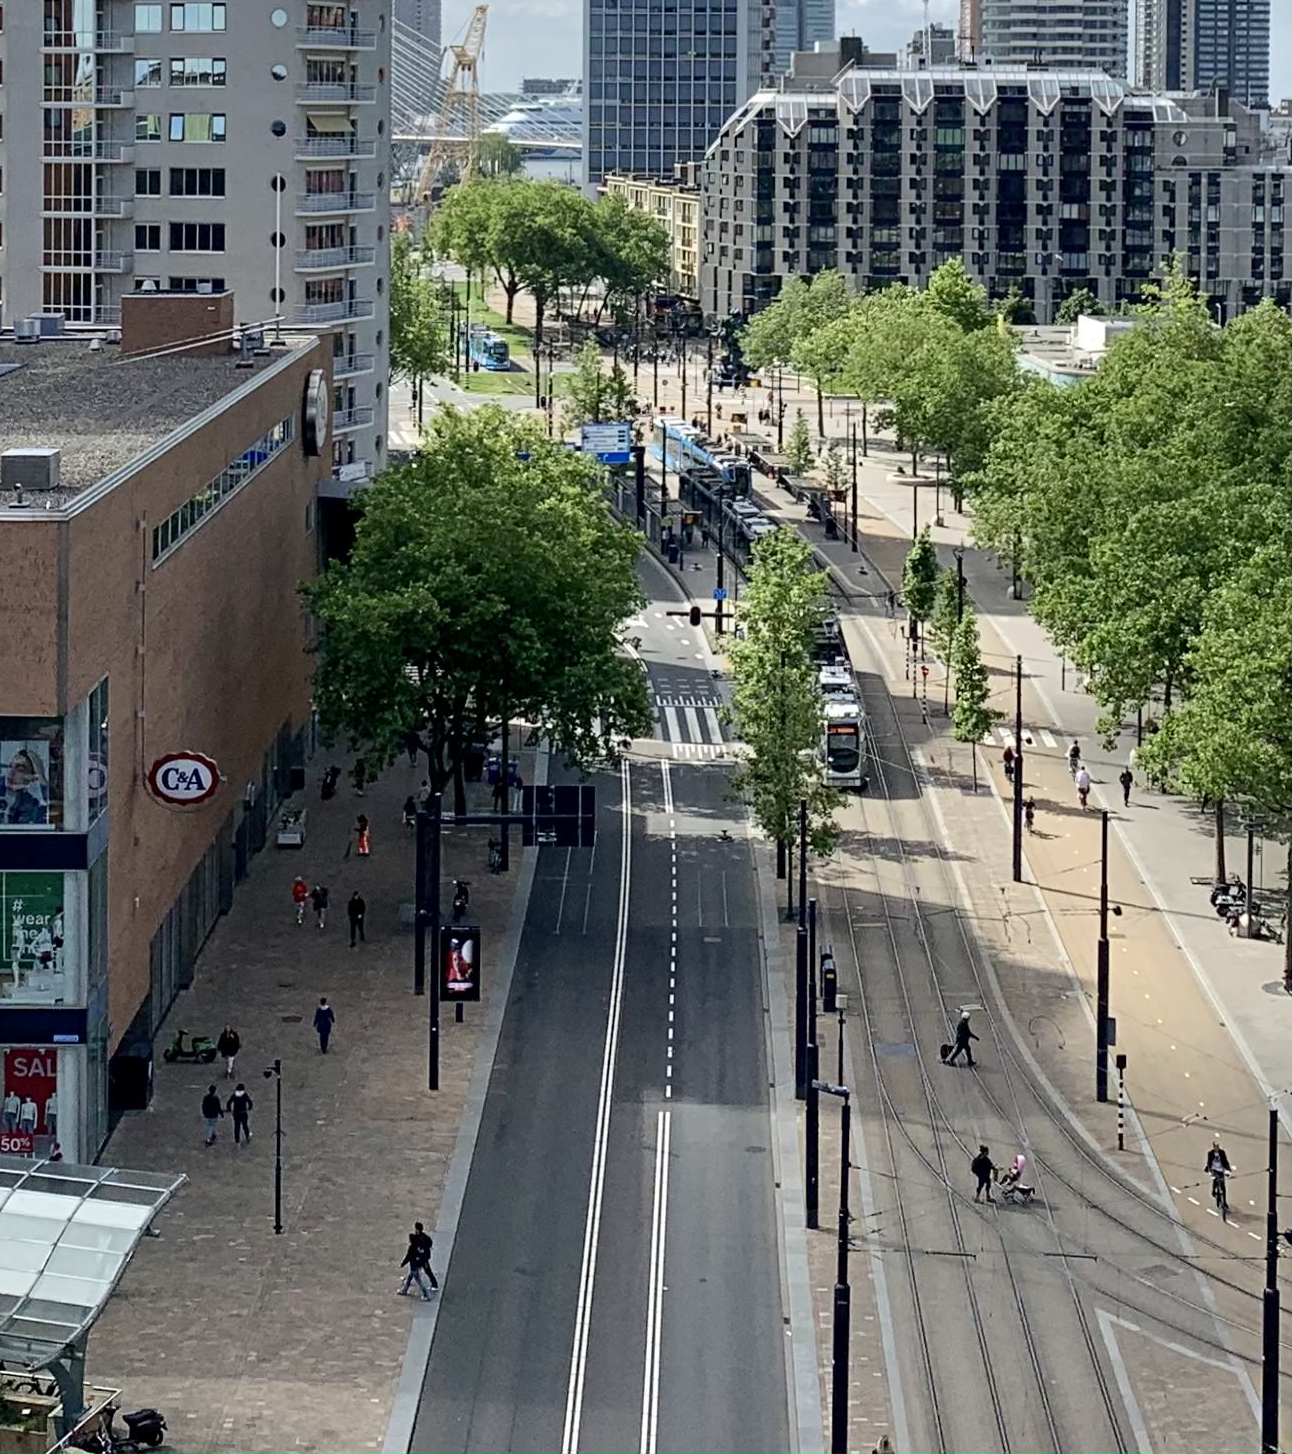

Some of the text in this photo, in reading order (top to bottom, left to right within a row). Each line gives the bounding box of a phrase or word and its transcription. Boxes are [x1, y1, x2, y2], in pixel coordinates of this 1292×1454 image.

[161, 767, 206, 791] C&A
[13, 1057, 57, 1078] SAL
[0, 1136, 31, 1152] 50%
